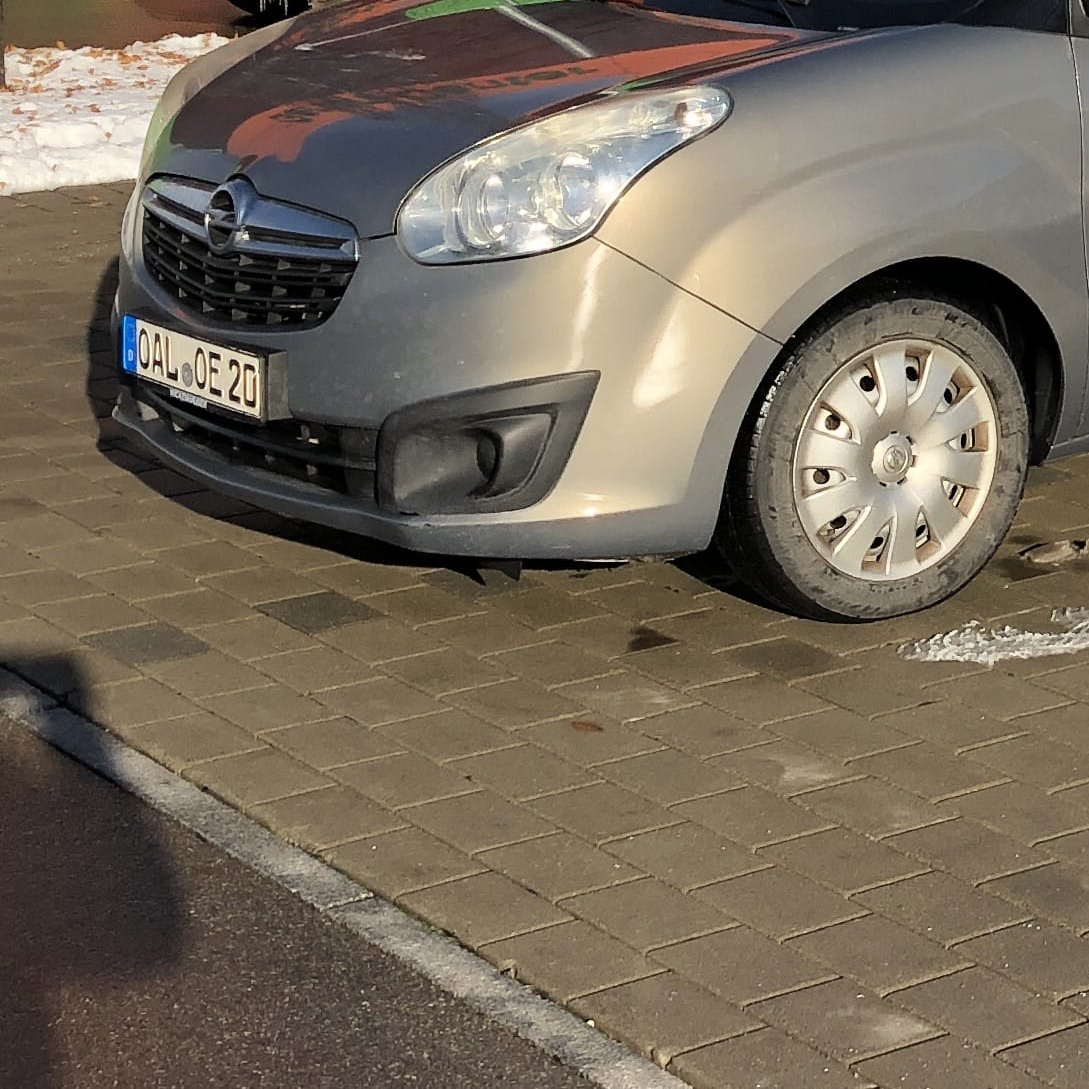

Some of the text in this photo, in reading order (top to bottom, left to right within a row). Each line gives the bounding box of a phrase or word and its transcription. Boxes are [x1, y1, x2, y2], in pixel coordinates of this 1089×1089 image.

[138, 328, 257, 408] OAL OE 20
